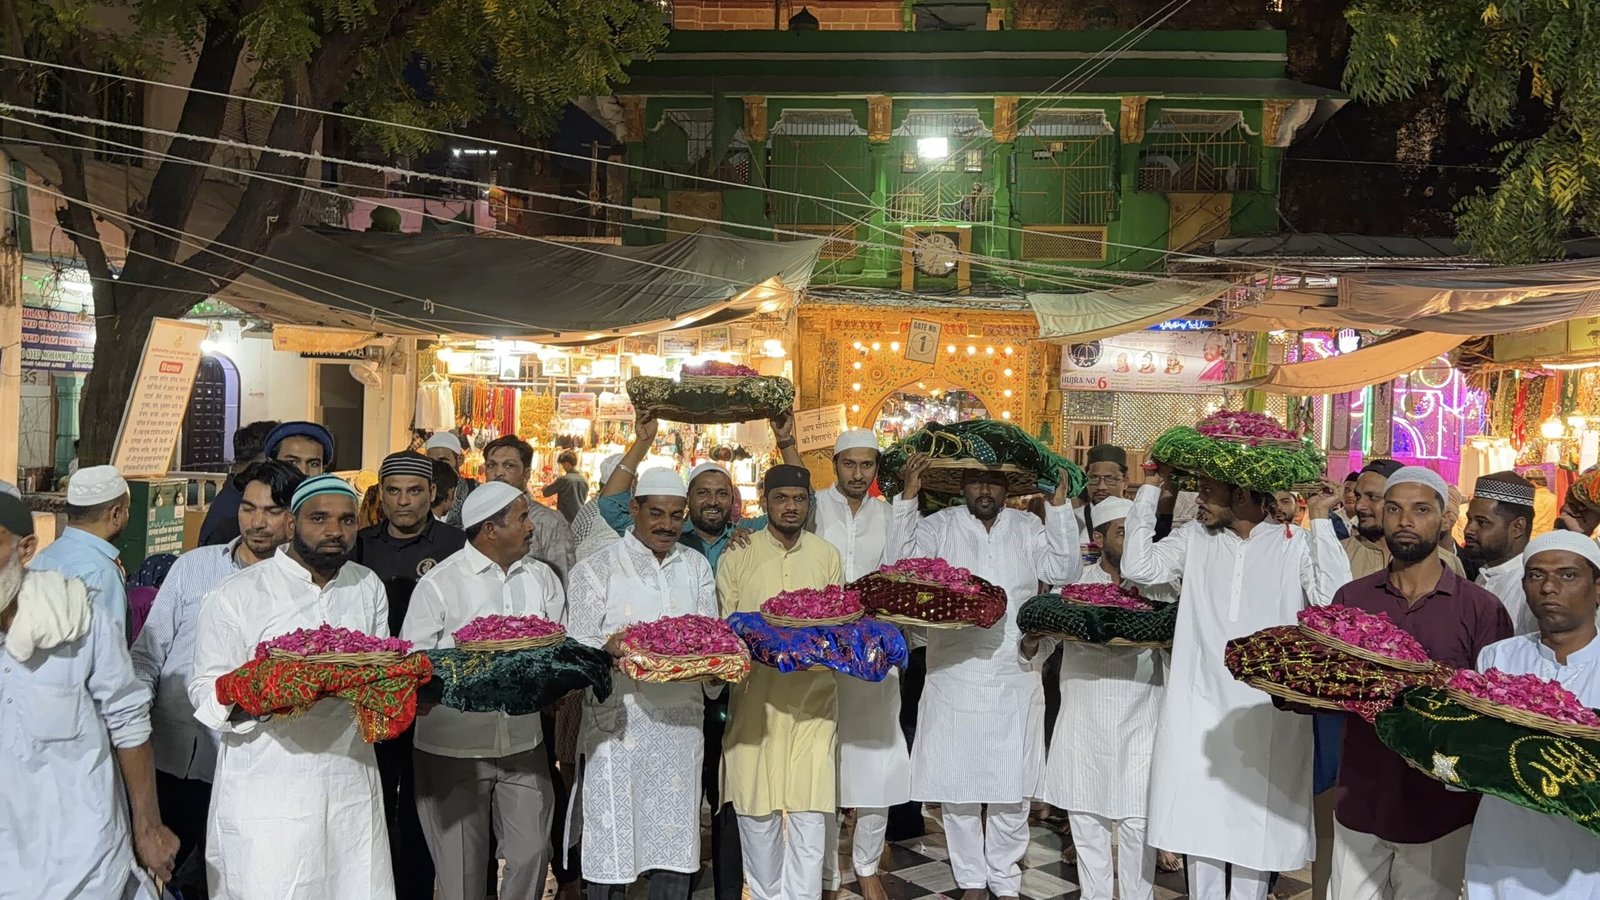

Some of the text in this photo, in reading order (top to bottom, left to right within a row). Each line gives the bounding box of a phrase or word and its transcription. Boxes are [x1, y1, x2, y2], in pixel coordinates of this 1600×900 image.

[913, 321, 928, 331] GATE
[920, 335, 927, 352] 1
[1061, 376, 1084, 385] HUJRA
[1097, 376, 1107, 389] 6
[802, 424, 814, 432] आप
